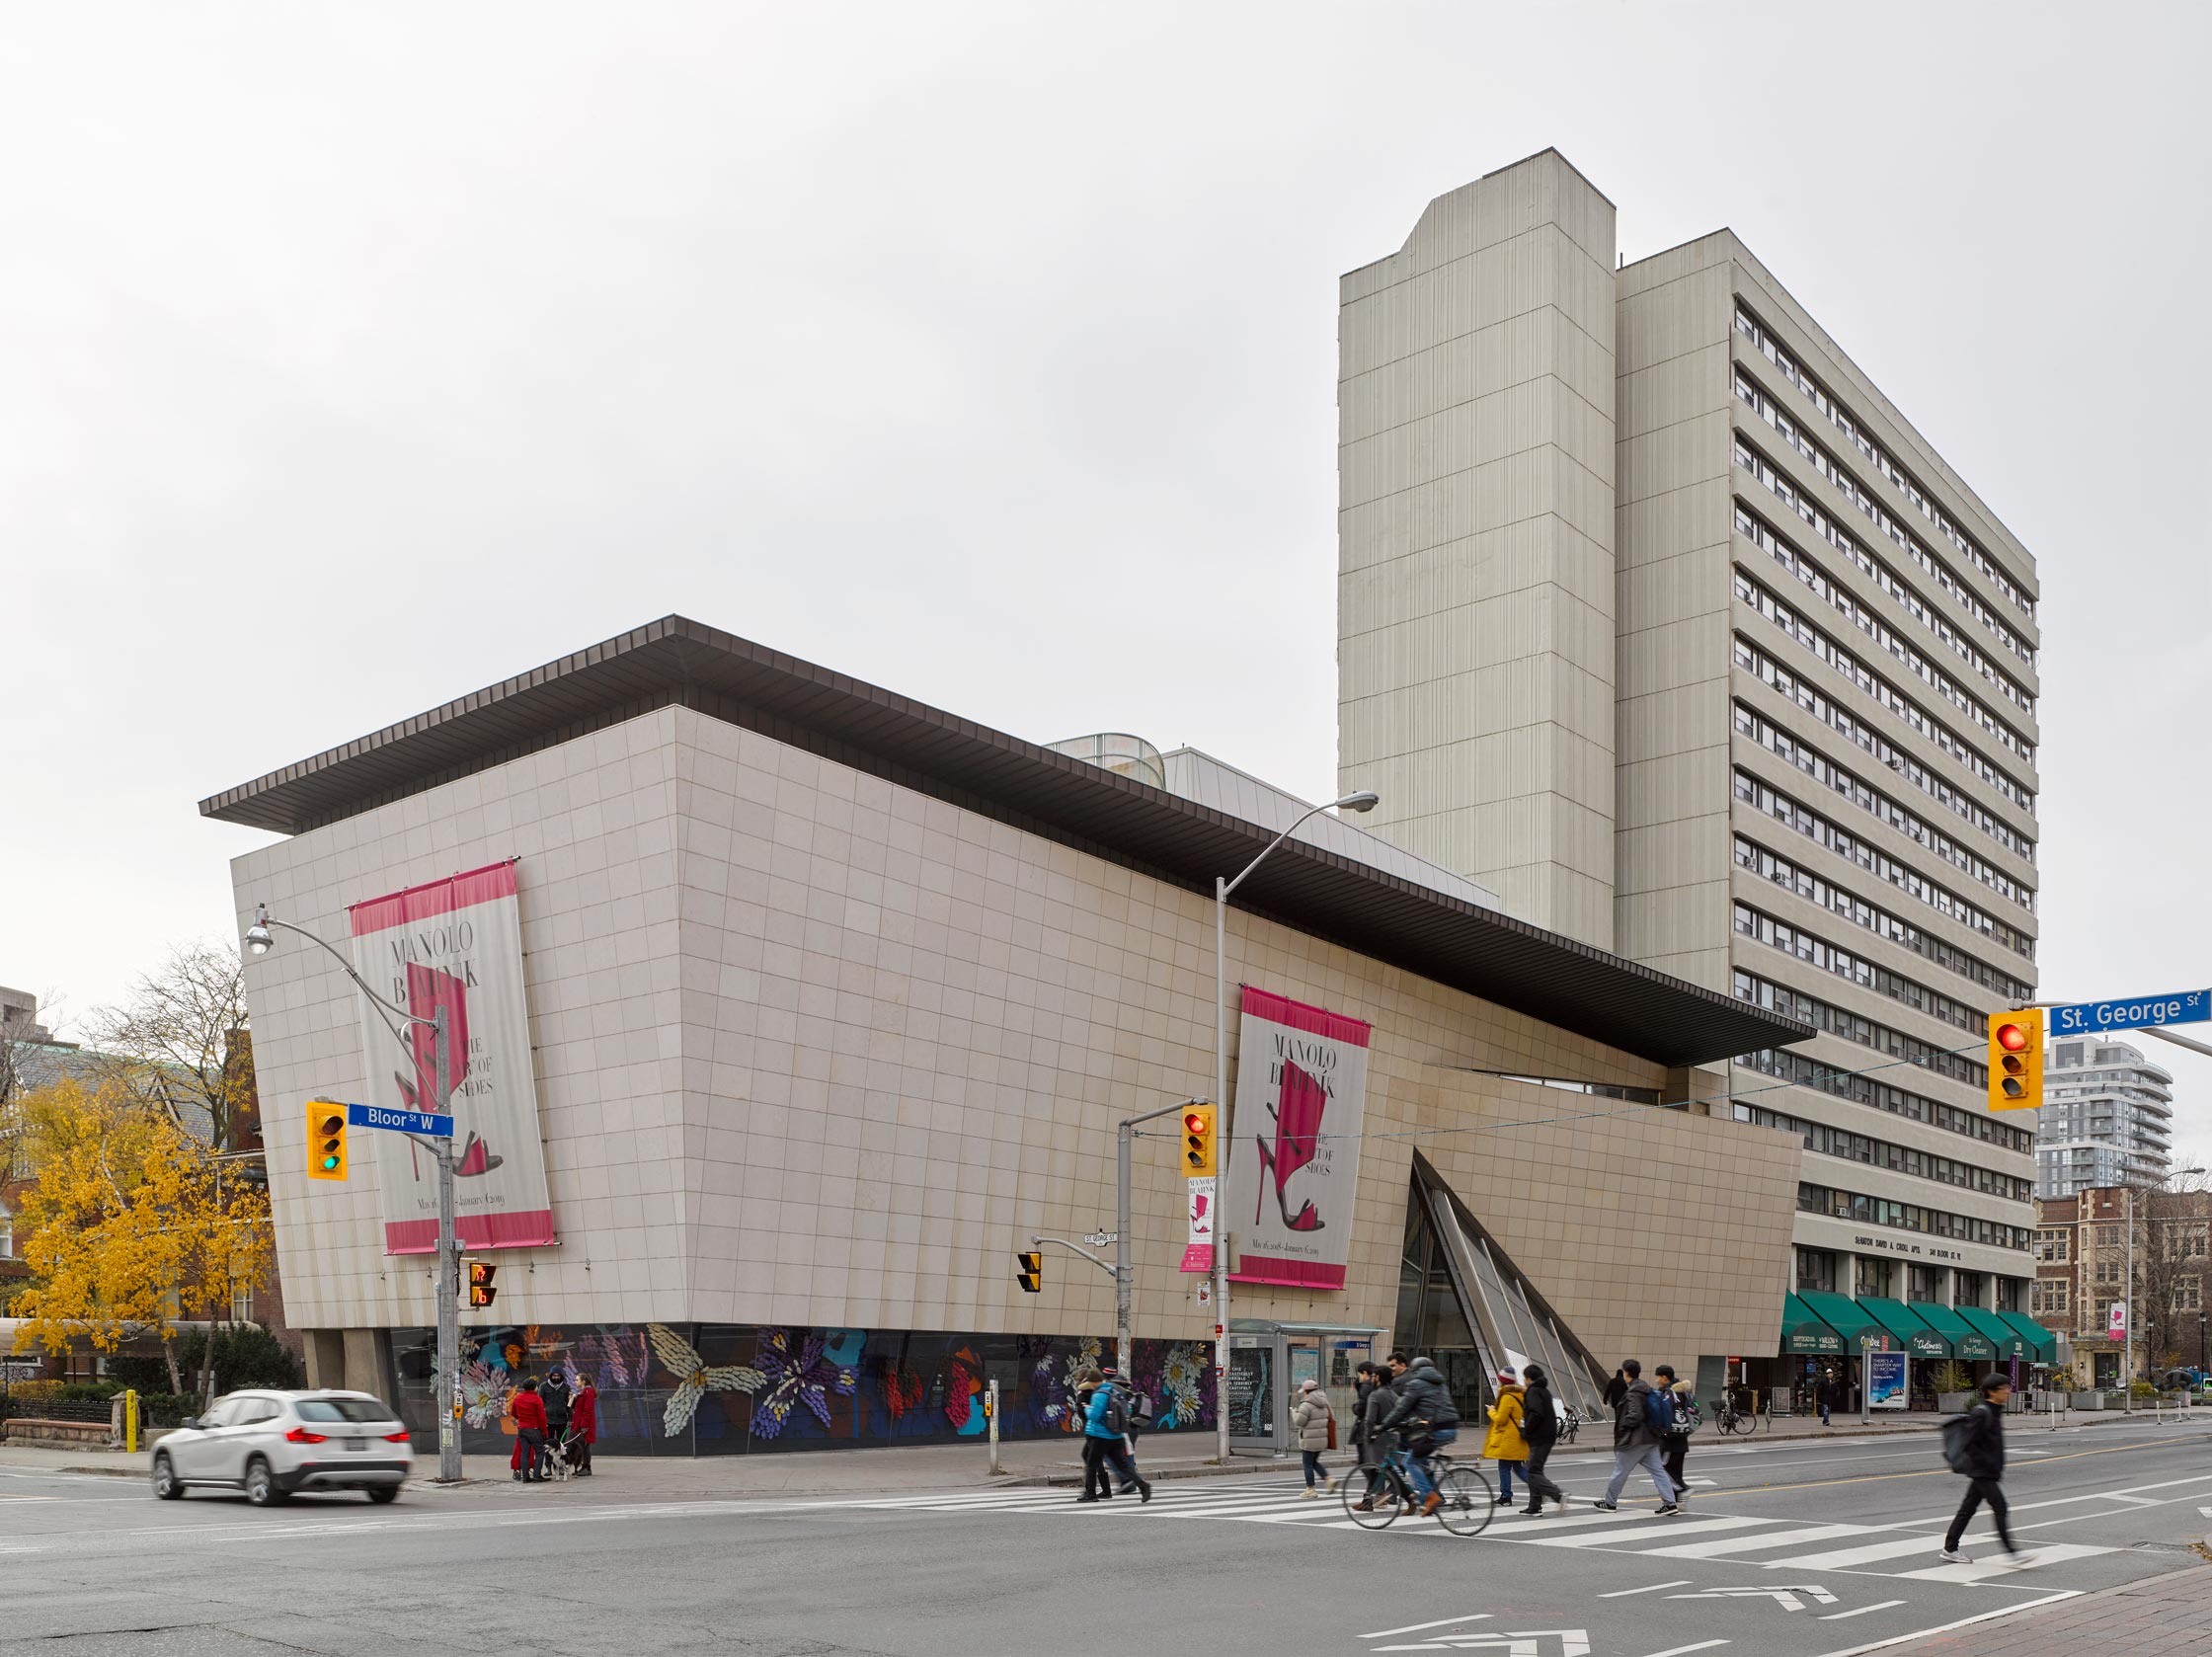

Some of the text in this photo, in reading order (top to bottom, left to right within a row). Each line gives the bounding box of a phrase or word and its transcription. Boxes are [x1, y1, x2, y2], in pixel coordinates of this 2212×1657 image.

[2061, 994, 2200, 1029] St. George St
[1272, 1032, 1337, 1070] MANOLO
[368, 1108, 434, 1130] Bloor St W
[1963, 1345, 1972, 1357] Dry
